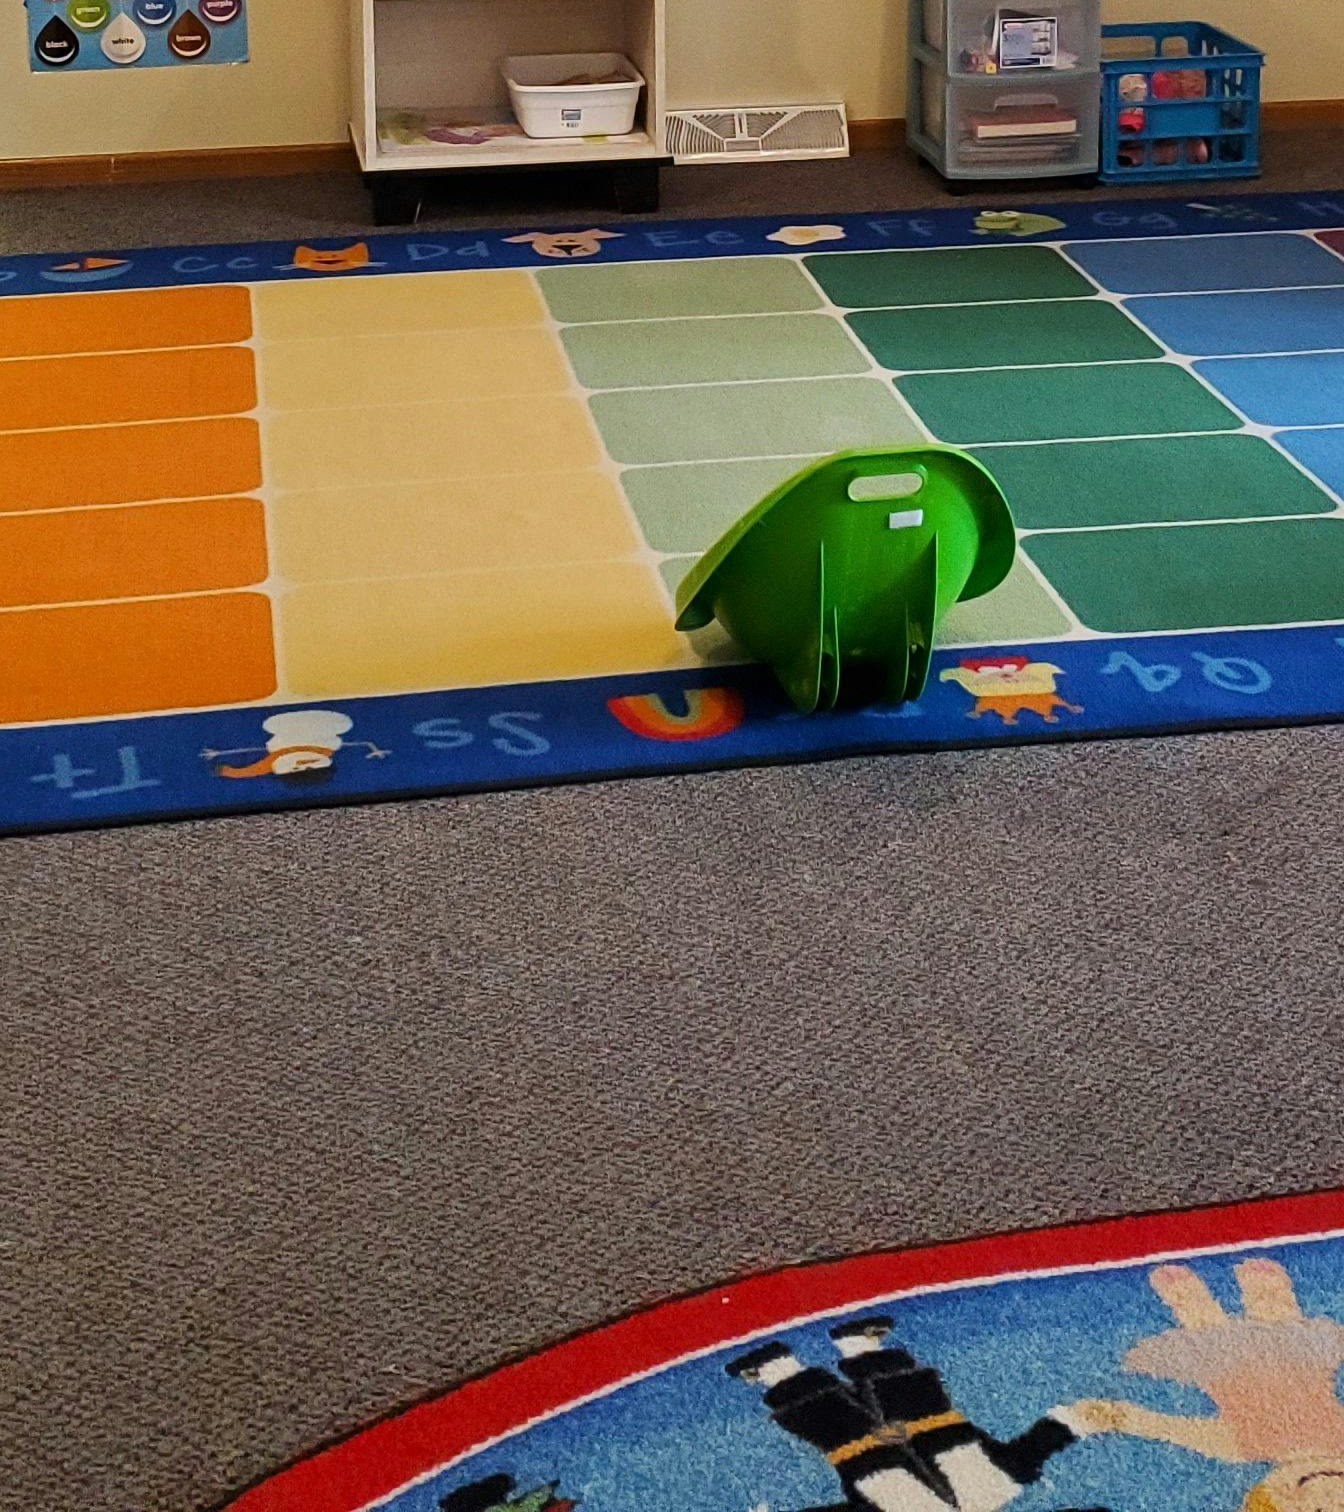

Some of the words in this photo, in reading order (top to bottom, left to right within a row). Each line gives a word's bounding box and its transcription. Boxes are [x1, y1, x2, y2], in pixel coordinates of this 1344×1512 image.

[145, 2, 164, 10] blue
[867, 216, 938, 239] Ff
[1090, 210, 1178, 233] Gg
[645, 229, 738, 248] Ee
[406, 240, 491, 263] Dd
[173, 254, 259, 275] Cc
[412, 711, 551, 758] Ss
[31, 745, 160, 801] Tt
